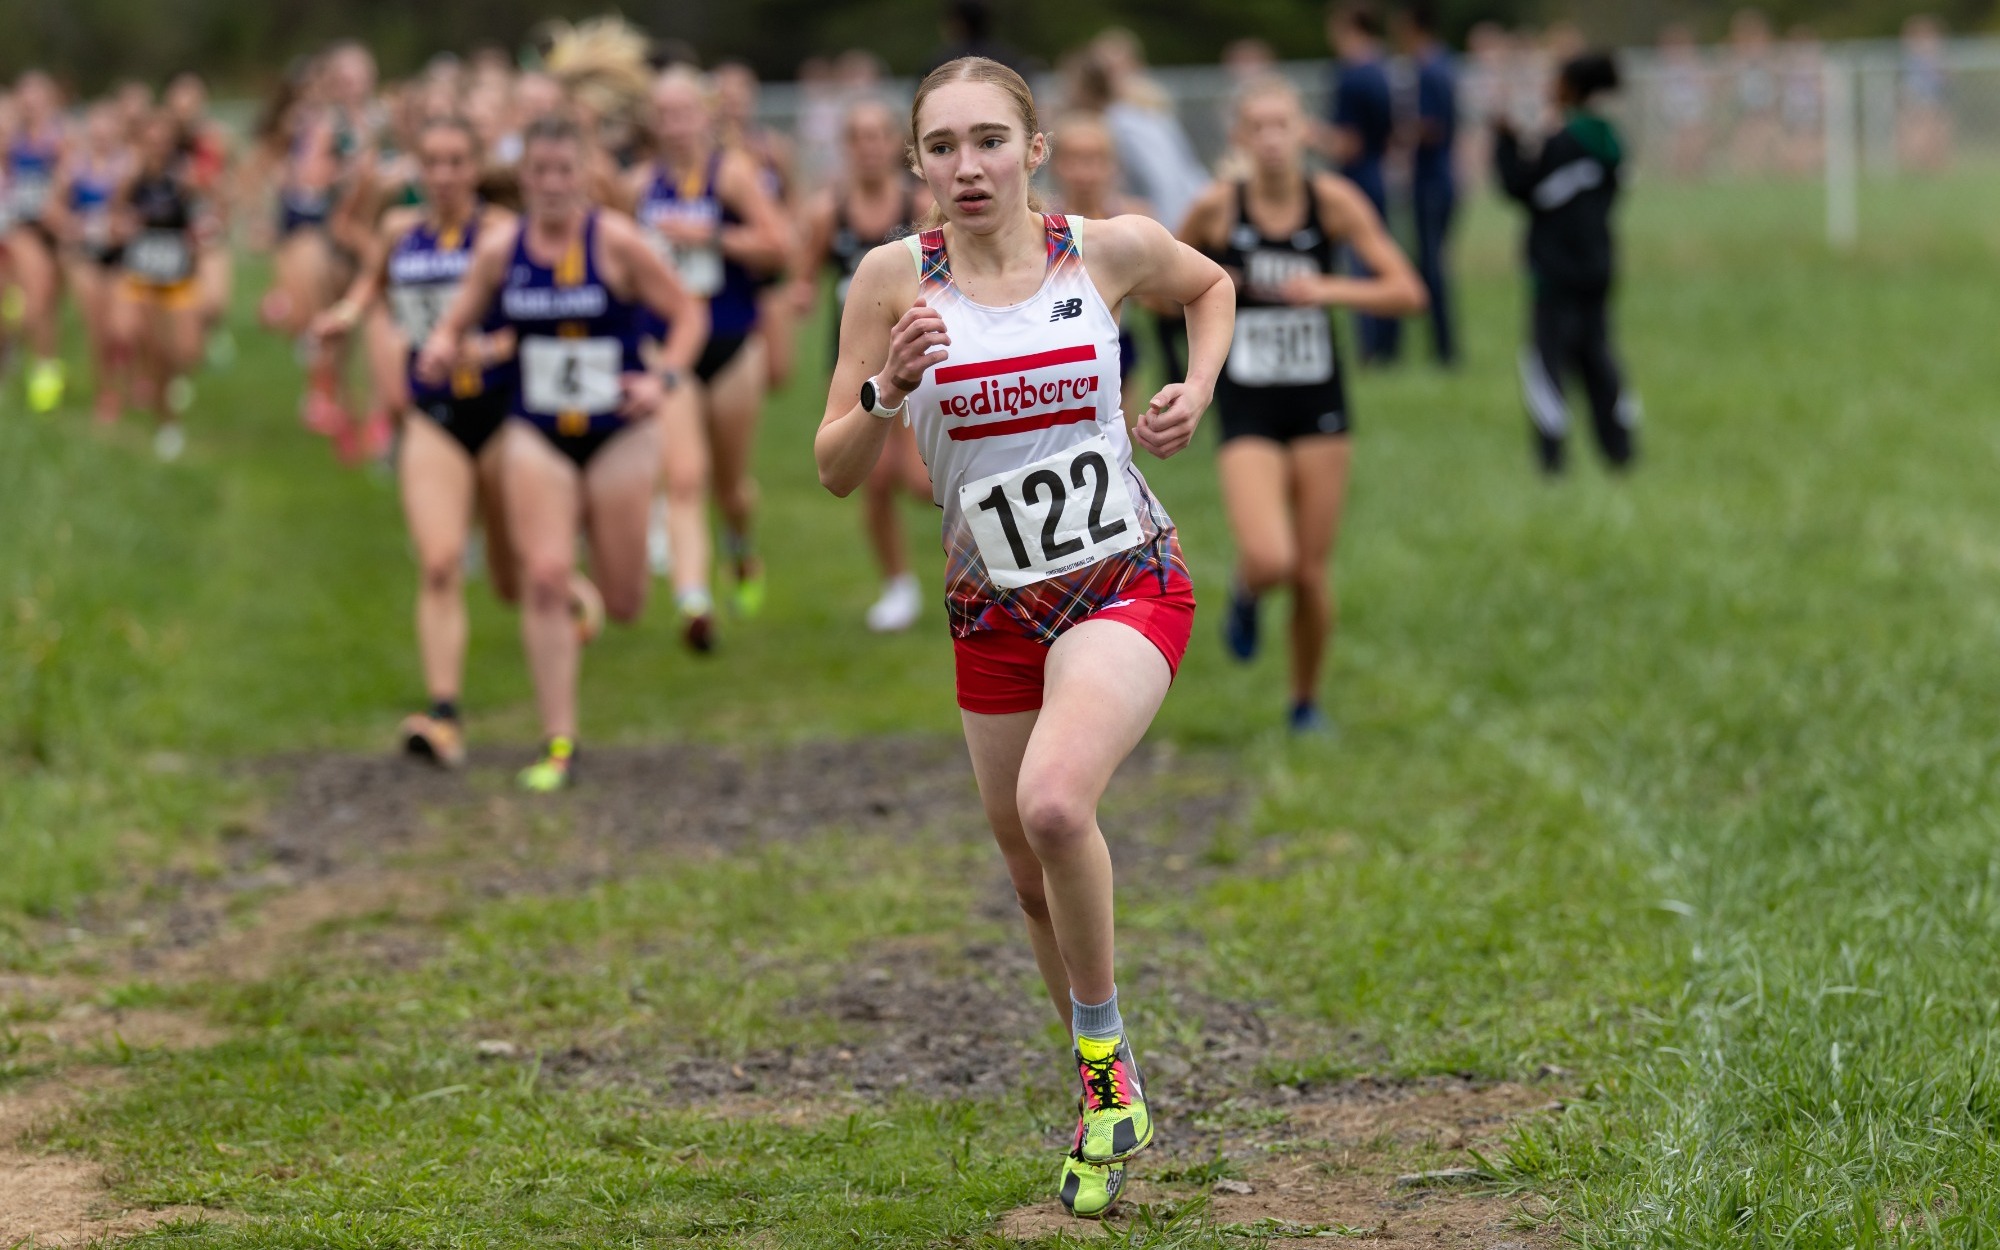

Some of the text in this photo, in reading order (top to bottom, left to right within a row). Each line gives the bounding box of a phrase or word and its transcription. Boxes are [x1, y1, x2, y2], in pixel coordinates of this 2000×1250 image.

[1049, 298, 1082, 322] NB
[951, 376, 1089, 417] edinboro
[978, 450, 1127, 570] 122
